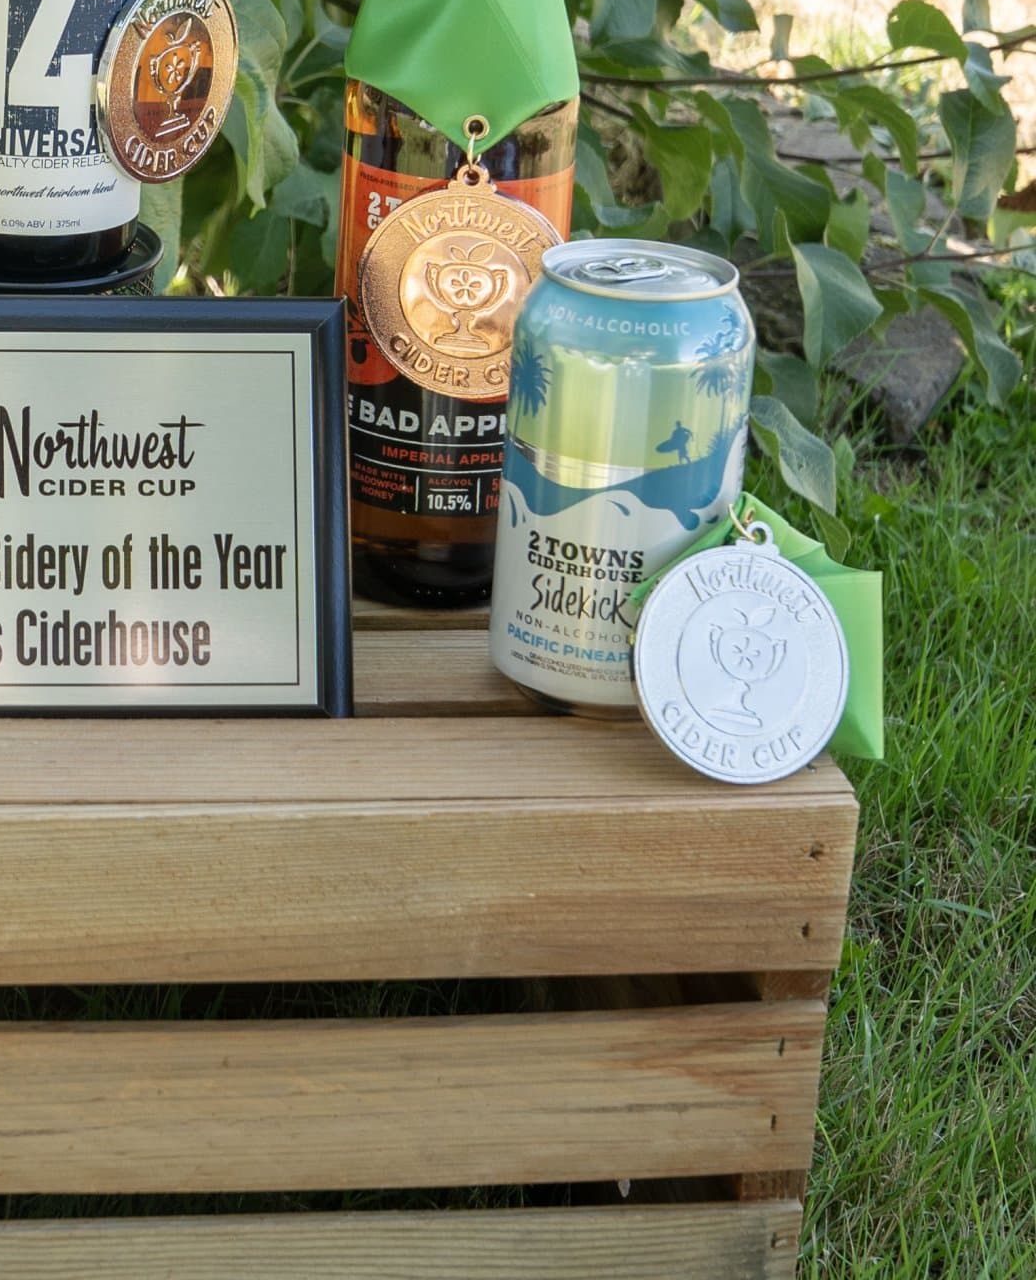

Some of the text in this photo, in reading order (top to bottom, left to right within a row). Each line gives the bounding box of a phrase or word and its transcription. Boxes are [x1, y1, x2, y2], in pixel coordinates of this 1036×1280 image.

[125, 106, 217, 172] CIDER CUP
[31, 158, 70, 169] CIDER
[46, 184, 91, 199] heirloom
[91, 178, 118, 196] blend
[366, 191, 381, 216] 2
[0, 219, 81, 228] 6.0% ABV 375ml
[398, 198, 541, 253] Northwest
[547, 303, 692, 337] NON-ALCOHOLIC
[389, 333, 470, 388] CIDER
[358, 399, 420, 433] BAD
[381, 445, 455, 465] IMPERIAL
[38, 478, 197, 497] CIDER CUP
[381, 470, 406, 480] WITH
[427, 478, 474, 487] ALC/VOL
[426, 494, 472, 510] 10.5%
[101, 532, 133, 590] of
[148, 532, 202, 590] the
[213, 533, 287, 590] Year
[528, 530, 645, 570] 2 TOWNS
[530, 573, 633, 629] Sidekick
[685, 554, 822, 623] Northwest
[16, 608, 211, 666] Ciderhouse
[507, 622, 559, 654] PACIFIC
[661, 699, 804, 769] CIDER CUP
